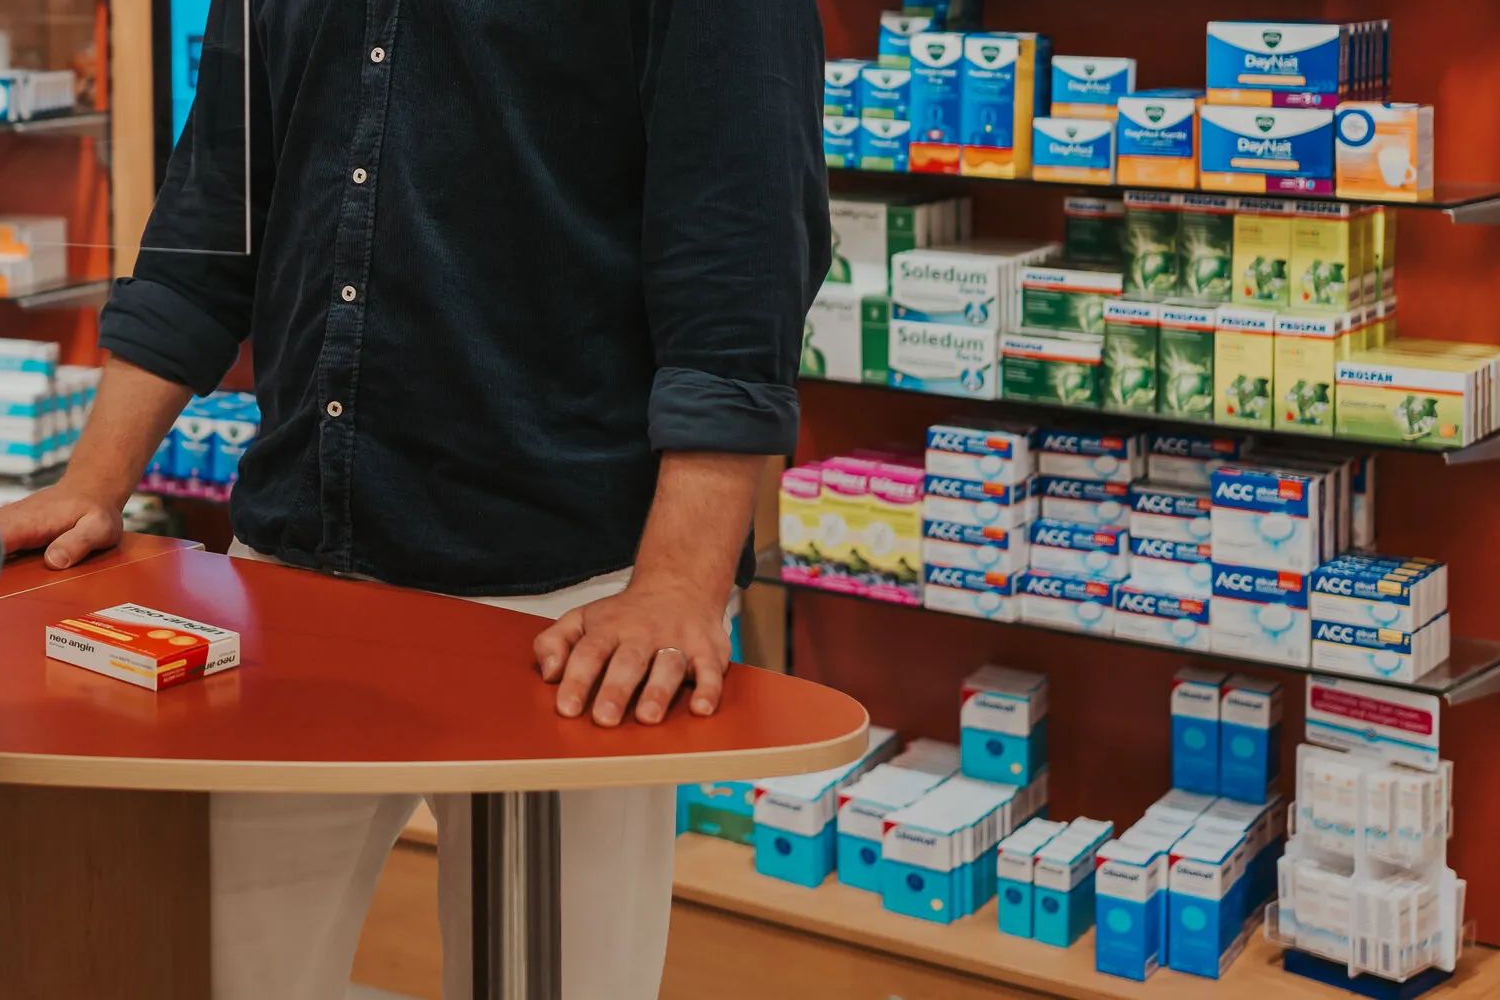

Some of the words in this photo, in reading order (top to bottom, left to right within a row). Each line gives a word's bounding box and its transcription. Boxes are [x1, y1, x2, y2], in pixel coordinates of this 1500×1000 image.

[1244, 53, 1299, 72] DayNait
[1237, 137, 1292, 156] DayNait
[901, 260, 988, 285] Soledum
[898, 326, 985, 352] Soledum
[1340, 368, 1393, 383] PROSPAN
[930, 433, 965, 452] ACC
[1044, 435, 1079, 452] ACC
[1153, 437, 1189, 453] ACC
[929, 478, 962, 497] ACC
[1047, 479, 1081, 496] ACC
[1216, 482, 1253, 501] ACC
[1137, 495, 1173, 514] ACC
[929, 521, 962, 541] ACC
[1036, 528, 1071, 547] ACC
[1138, 539, 1174, 558] ACC
[930, 566, 963, 587] ACC
[1216, 571, 1252, 592] ACC
[1316, 576, 1353, 595] ACC
[1027, 576, 1063, 597] ACC
[1119, 595, 1156, 613] ACC
[122, 605, 163, 619] neo
[164, 616, 226, 635] angin
[1317, 624, 1354, 642] ACC
[49, 633, 67, 645] neo
[68, 639, 95, 653] angin
